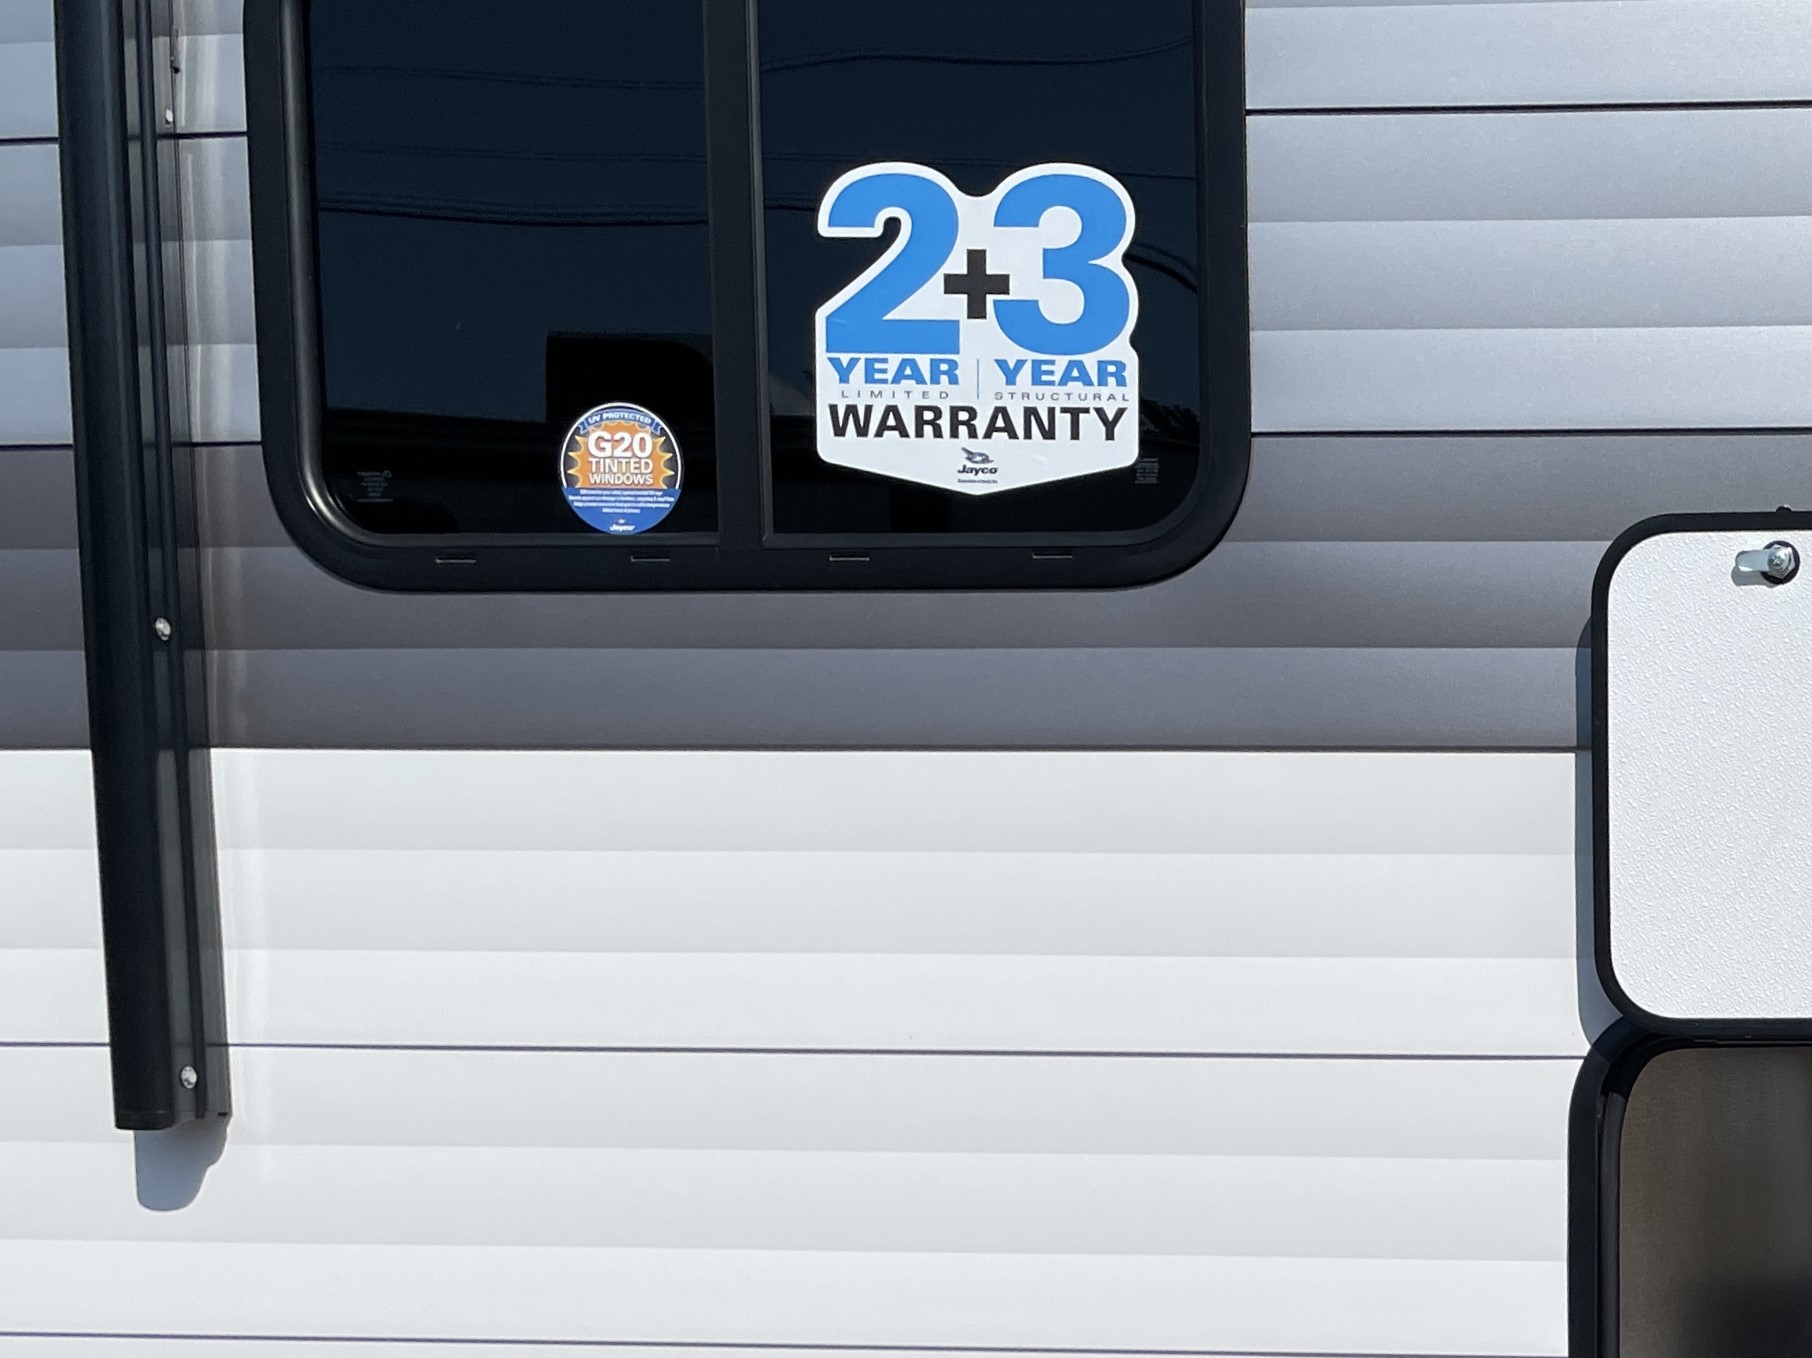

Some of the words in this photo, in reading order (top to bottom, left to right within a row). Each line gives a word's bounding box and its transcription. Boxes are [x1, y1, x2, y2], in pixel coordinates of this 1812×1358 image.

[827, 356, 960, 386] YEAR
[993, 358, 1128, 388] YEAR
[841, 389, 950, 400] LIMITED
[993, 391, 1130, 402] STRUCTURAL
[588, 418, 604, 426] UV
[604, 412, 652, 426] PROTECTED
[828, 403, 1128, 441] WARRANTY
[588, 431, 655, 458] G20
[588, 458, 655, 474] TINTED
[957, 464, 998, 476] Jayco
[589, 474, 655, 486] WINDOWS
